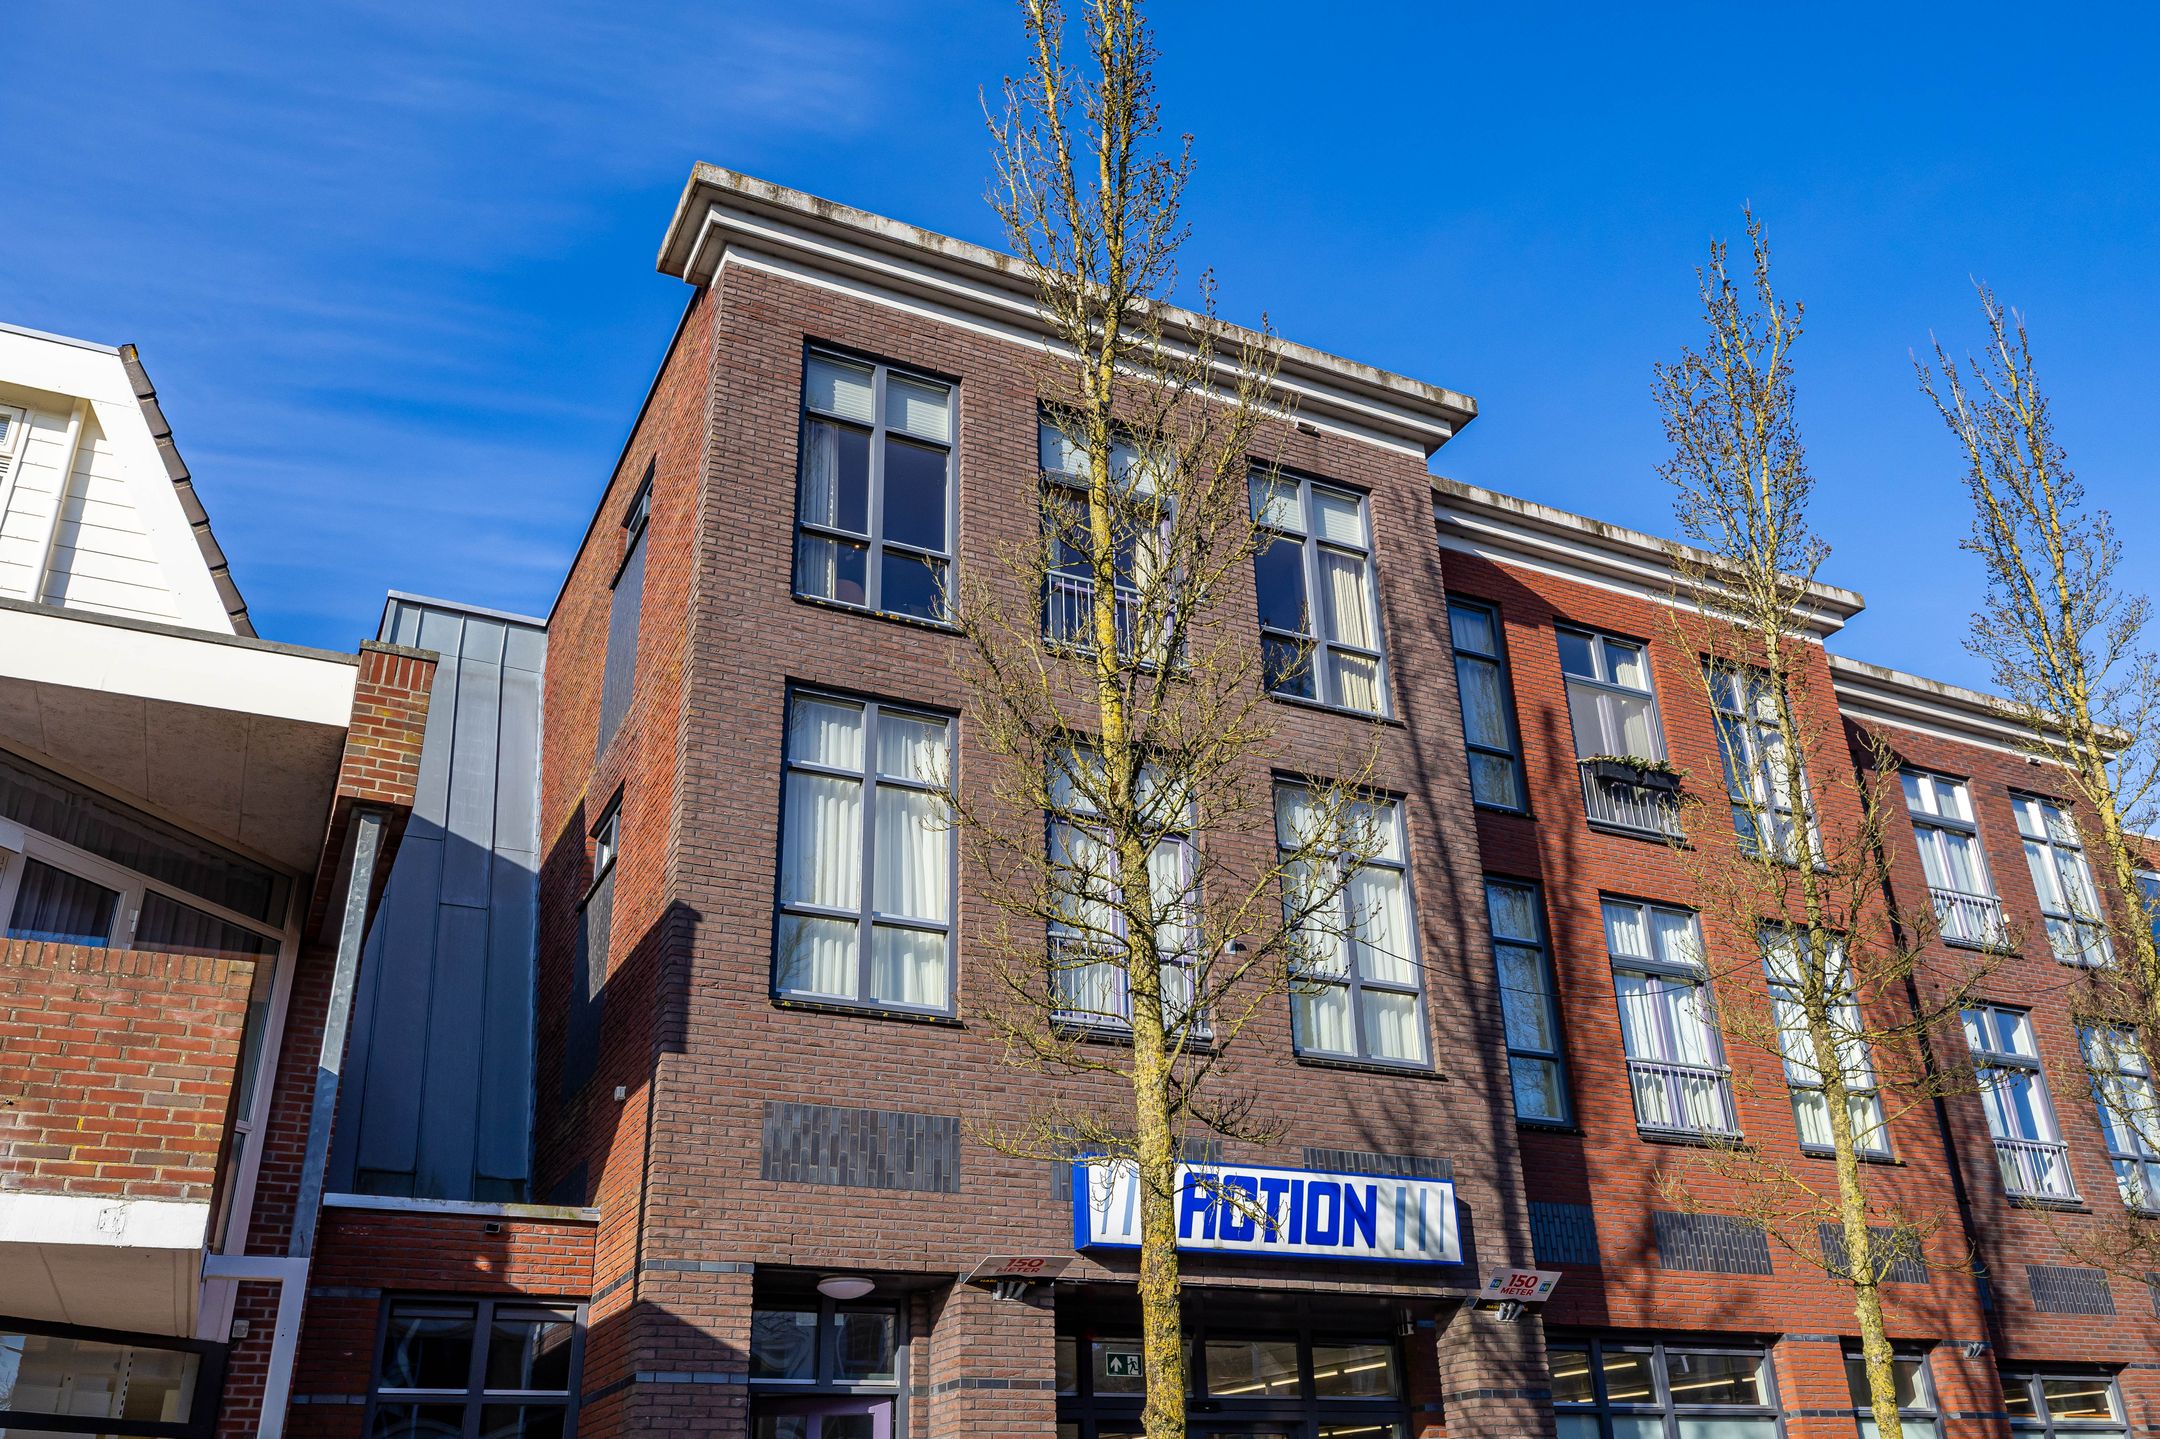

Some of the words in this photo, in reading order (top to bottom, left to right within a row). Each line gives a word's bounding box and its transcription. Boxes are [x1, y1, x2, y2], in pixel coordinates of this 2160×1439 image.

[1178, 1171, 1378, 1249] ACTION
[1005, 1258, 1045, 1268] 150
[1508, 1274, 1539, 1288] 150
[1500, 1287, 1534, 1296] METER
